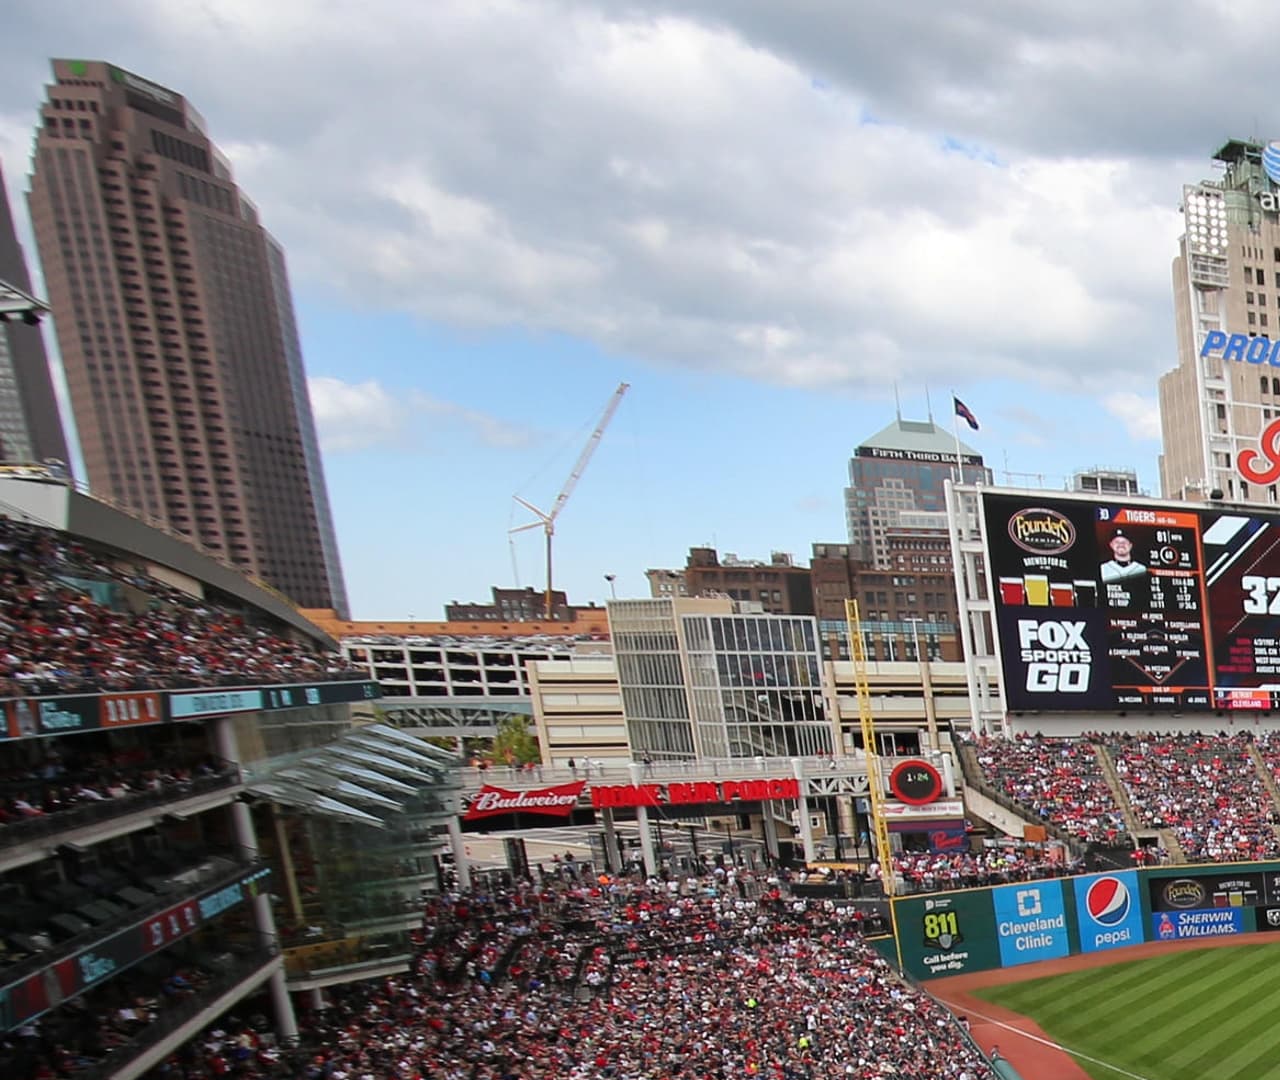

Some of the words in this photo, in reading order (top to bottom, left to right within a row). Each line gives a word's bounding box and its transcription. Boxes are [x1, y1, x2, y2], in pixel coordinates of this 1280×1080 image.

[872, 448, 903, 458] FIFTH
[904, 451, 940, 461] THIRD
[1125, 509, 1156, 523] TIGERS
[1015, 514, 1070, 544] Founders
[1017, 619, 1090, 650] FOX
[1021, 650, 1092, 663] SPORTS
[1026, 662, 1091, 692] GO
[1231, 691, 1253, 699] DETROIT
[1232, 700, 1262, 708] CLEVELAND
[477, 791, 578, 810] Budweiser
[591, 783, 663, 808] HOME
[668, 781, 718, 803] RUN
[721, 778, 799, 801] PORCH
[1168, 882, 1201, 901] Founders
[925, 911, 958, 940] 811
[1000, 913, 1064, 938] Cleveland
[1179, 911, 1233, 923] SHERWIN
[1095, 927, 1131, 947] pepsi
[1178, 924, 1237, 937] WILLIAMS.
[1015, 934, 1053, 951] Clinic
[923, 955, 940, 965] Call
[940, 950, 968, 962] before
[930, 963, 946, 974] you
[947, 960, 964, 972] dig.
